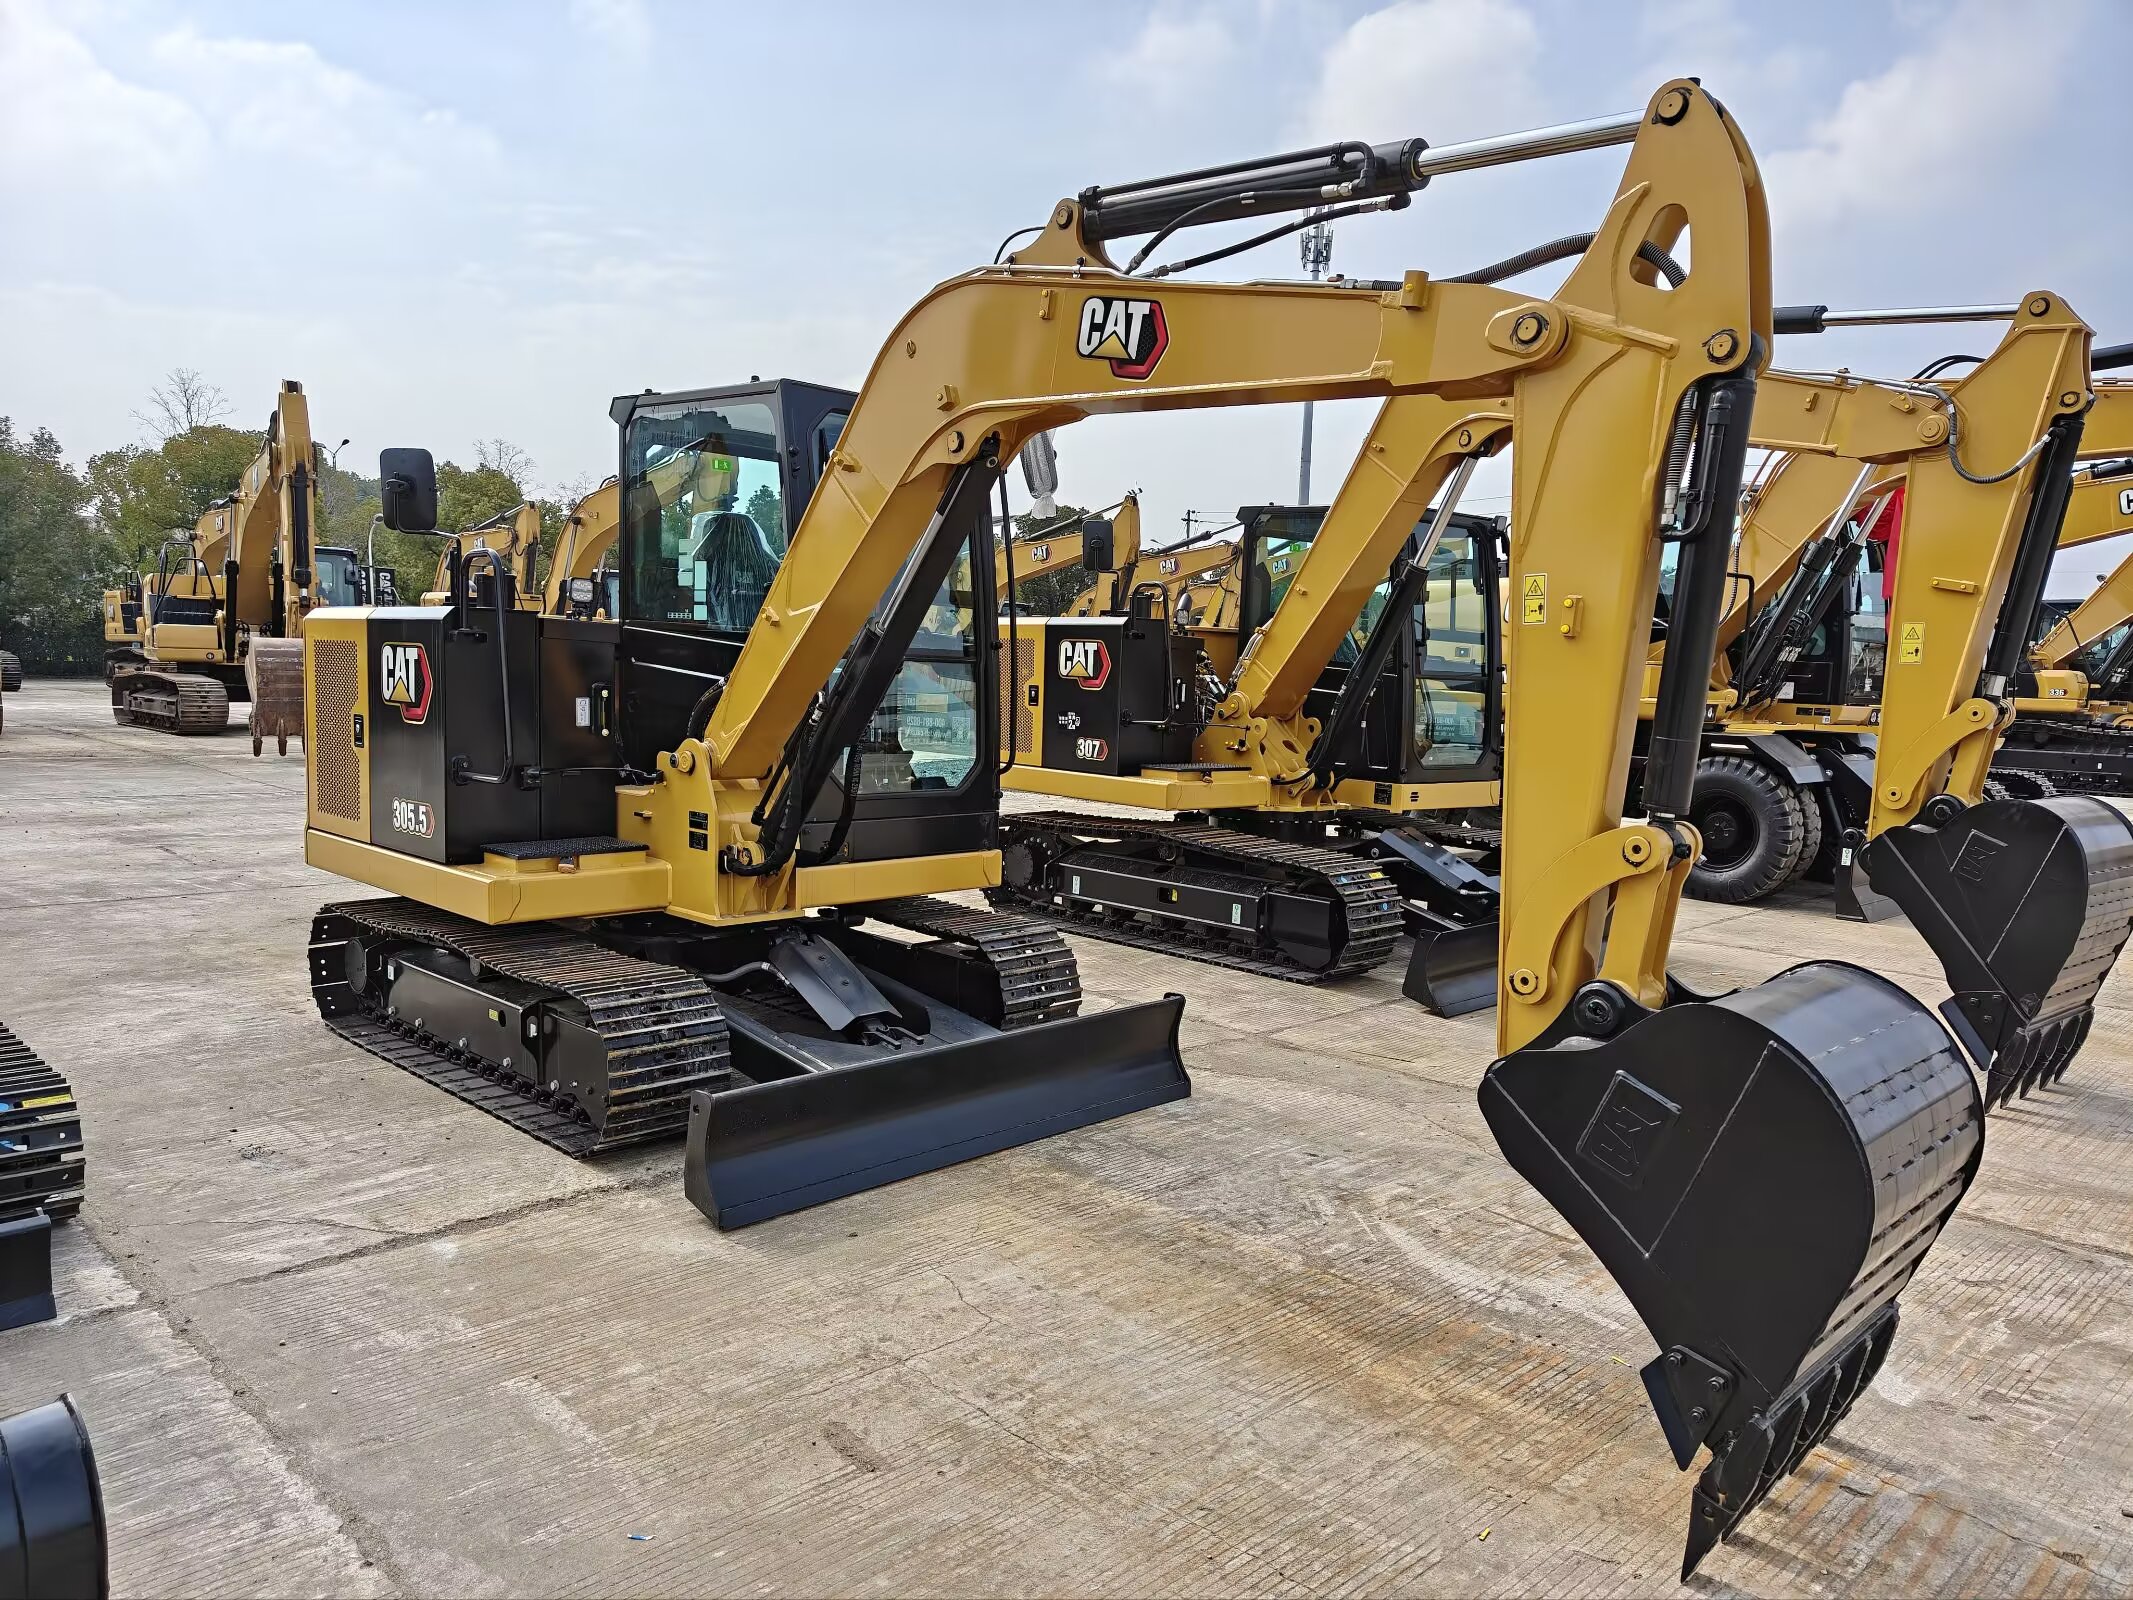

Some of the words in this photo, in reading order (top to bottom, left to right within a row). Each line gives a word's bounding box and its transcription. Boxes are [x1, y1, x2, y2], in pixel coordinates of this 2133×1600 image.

[1078, 298, 1151, 360] CAT
[1032, 545, 1049, 562] CAT
[1159, 558, 1177, 575] CAT
[1272, 558, 1288, 574] CAT
[1060, 641, 1098, 678] CAT
[382, 645, 419, 703] CAT
[1077, 739, 1100, 759] 307
[393, 800, 428, 834] 305.5
